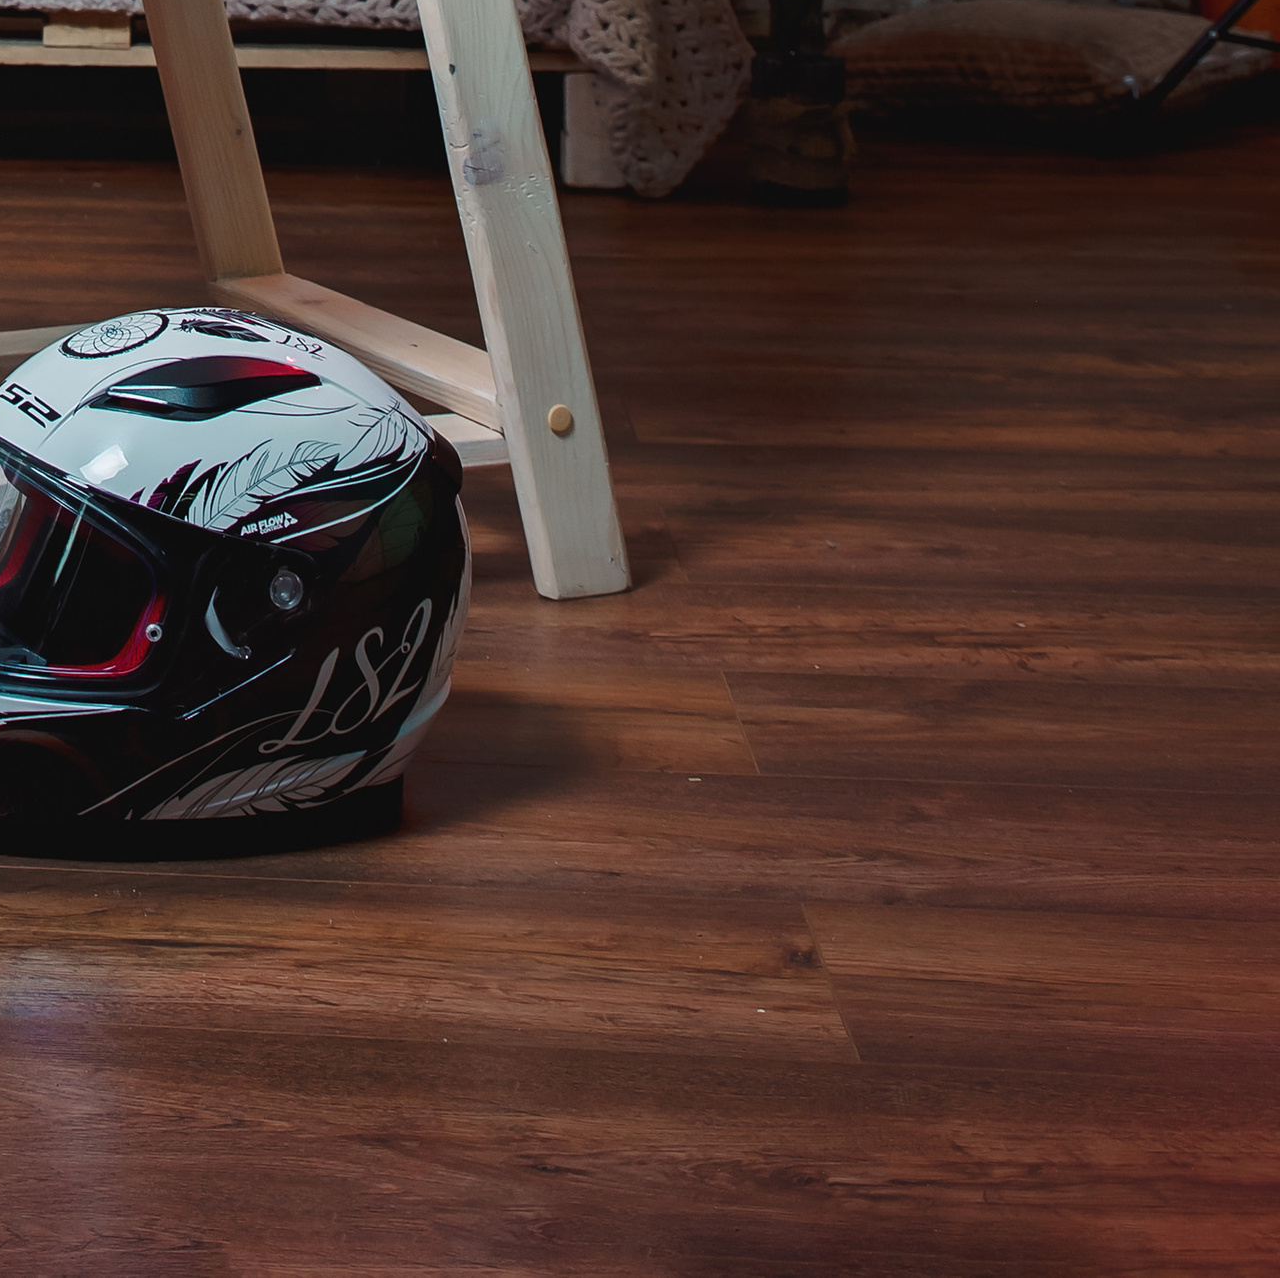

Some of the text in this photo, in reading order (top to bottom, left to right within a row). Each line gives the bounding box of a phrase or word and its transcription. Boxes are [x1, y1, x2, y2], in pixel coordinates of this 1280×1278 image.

[240, 514, 284, 537] AIR FLOW
[257, 597, 433, 754] LS2
